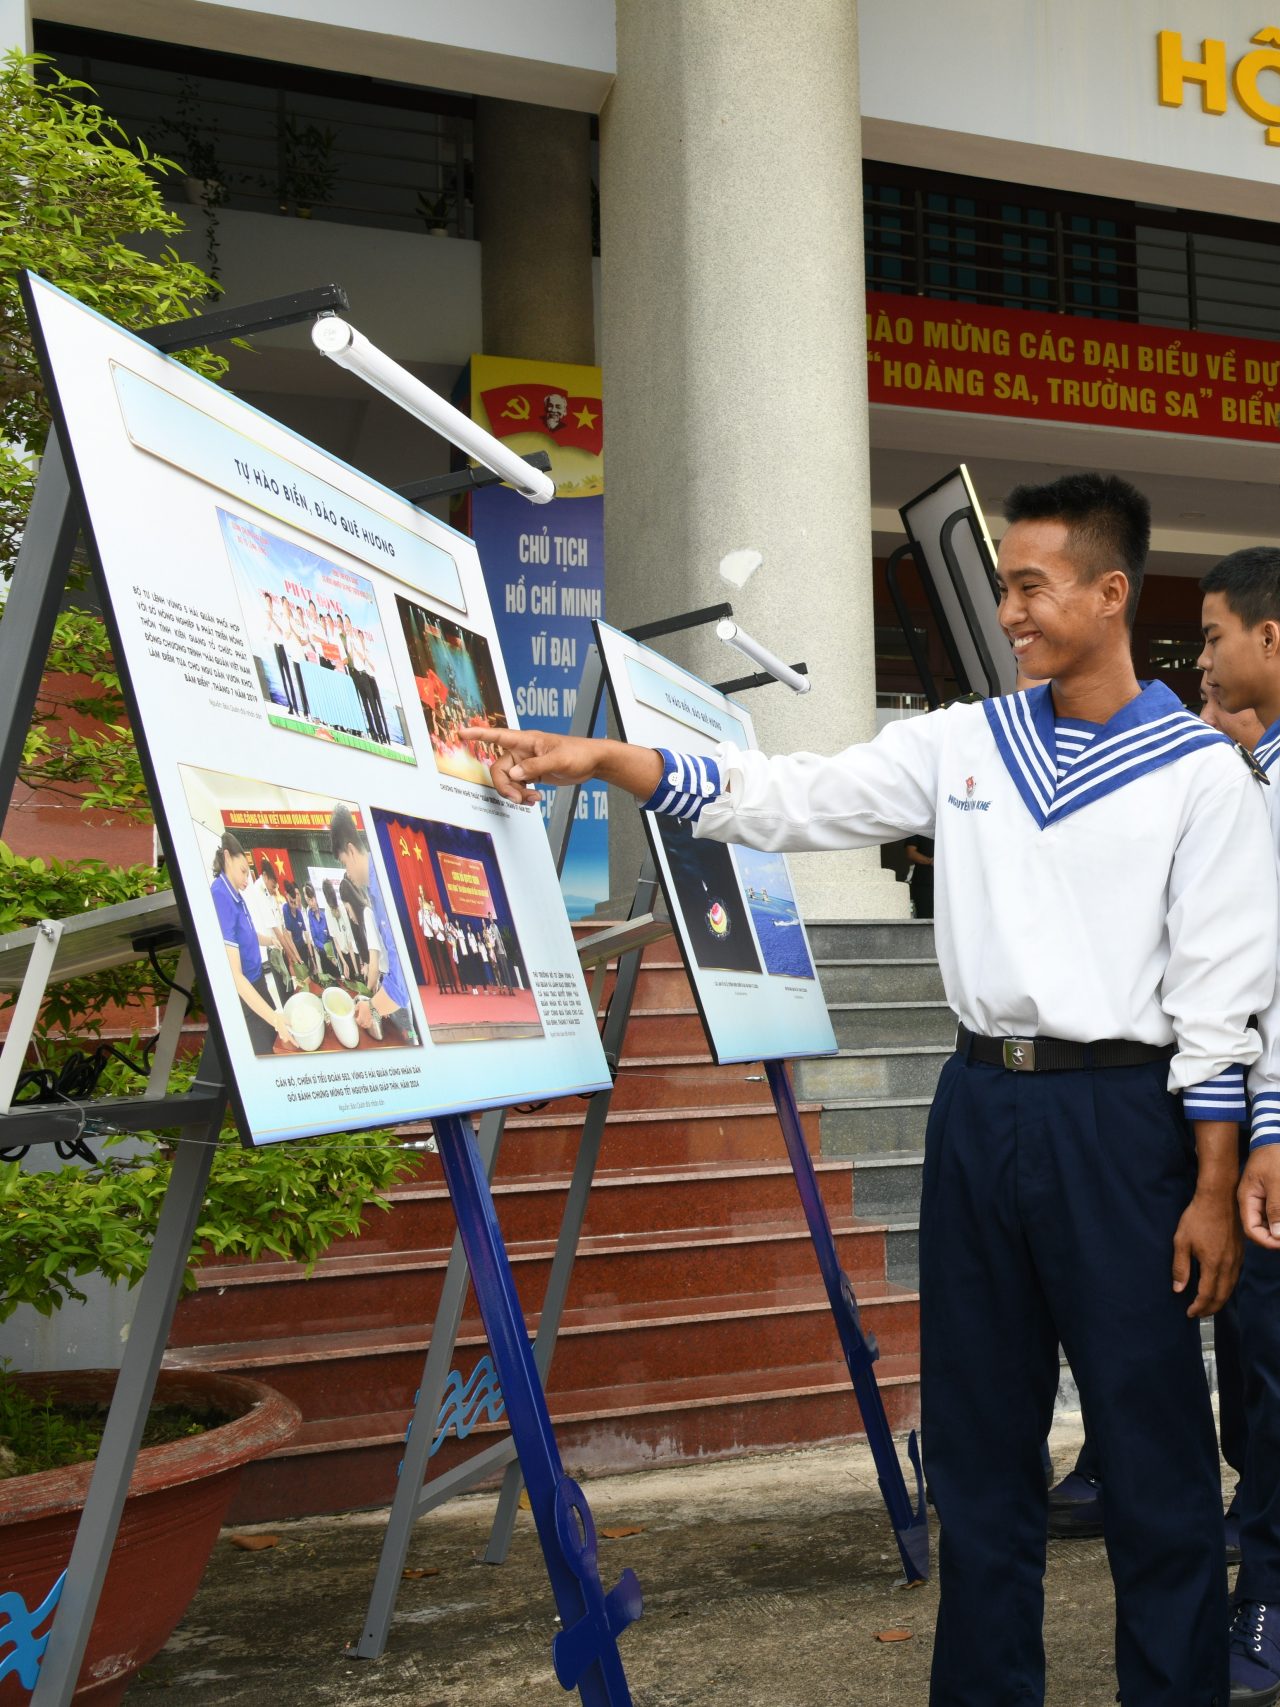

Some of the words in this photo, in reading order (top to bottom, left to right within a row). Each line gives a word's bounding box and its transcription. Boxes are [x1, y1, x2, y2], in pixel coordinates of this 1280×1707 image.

[866, 309, 913, 345] ÀO
[923, 318, 1010, 357] MỪNG
[1019, 329, 1075, 363] CÁC
[1083, 339, 1129, 374] ĐẠI
[1138, 340, 1198, 378] BIỂU
[1206, 349, 1237, 382] VỀ
[1245, 359, 1280, 391] DỰ
[993, 373, 1039, 406] SA,
[1047, 377, 1156, 415] TRƯỜNG
[1222, 390, 1280, 429] BIỂN
[234, 458, 250, 484] TỰ
[253, 469, 280, 496] HÀO
[314, 500, 337, 526] ĐẢO
[340, 517, 360, 539] QUÊ
[519, 526, 550, 565] CHỦ
[554, 536, 588, 573] TỊCH
[505, 574, 526, 614] HỒ
[531, 580, 557, 616] CHÍ
[561, 587, 602, 618] MINH
[532, 631, 547, 666] VĨ
[551, 638, 576, 673] ĐẠI
[516, 676, 558, 717] SỐNG
[592, 791, 609, 820] TA
